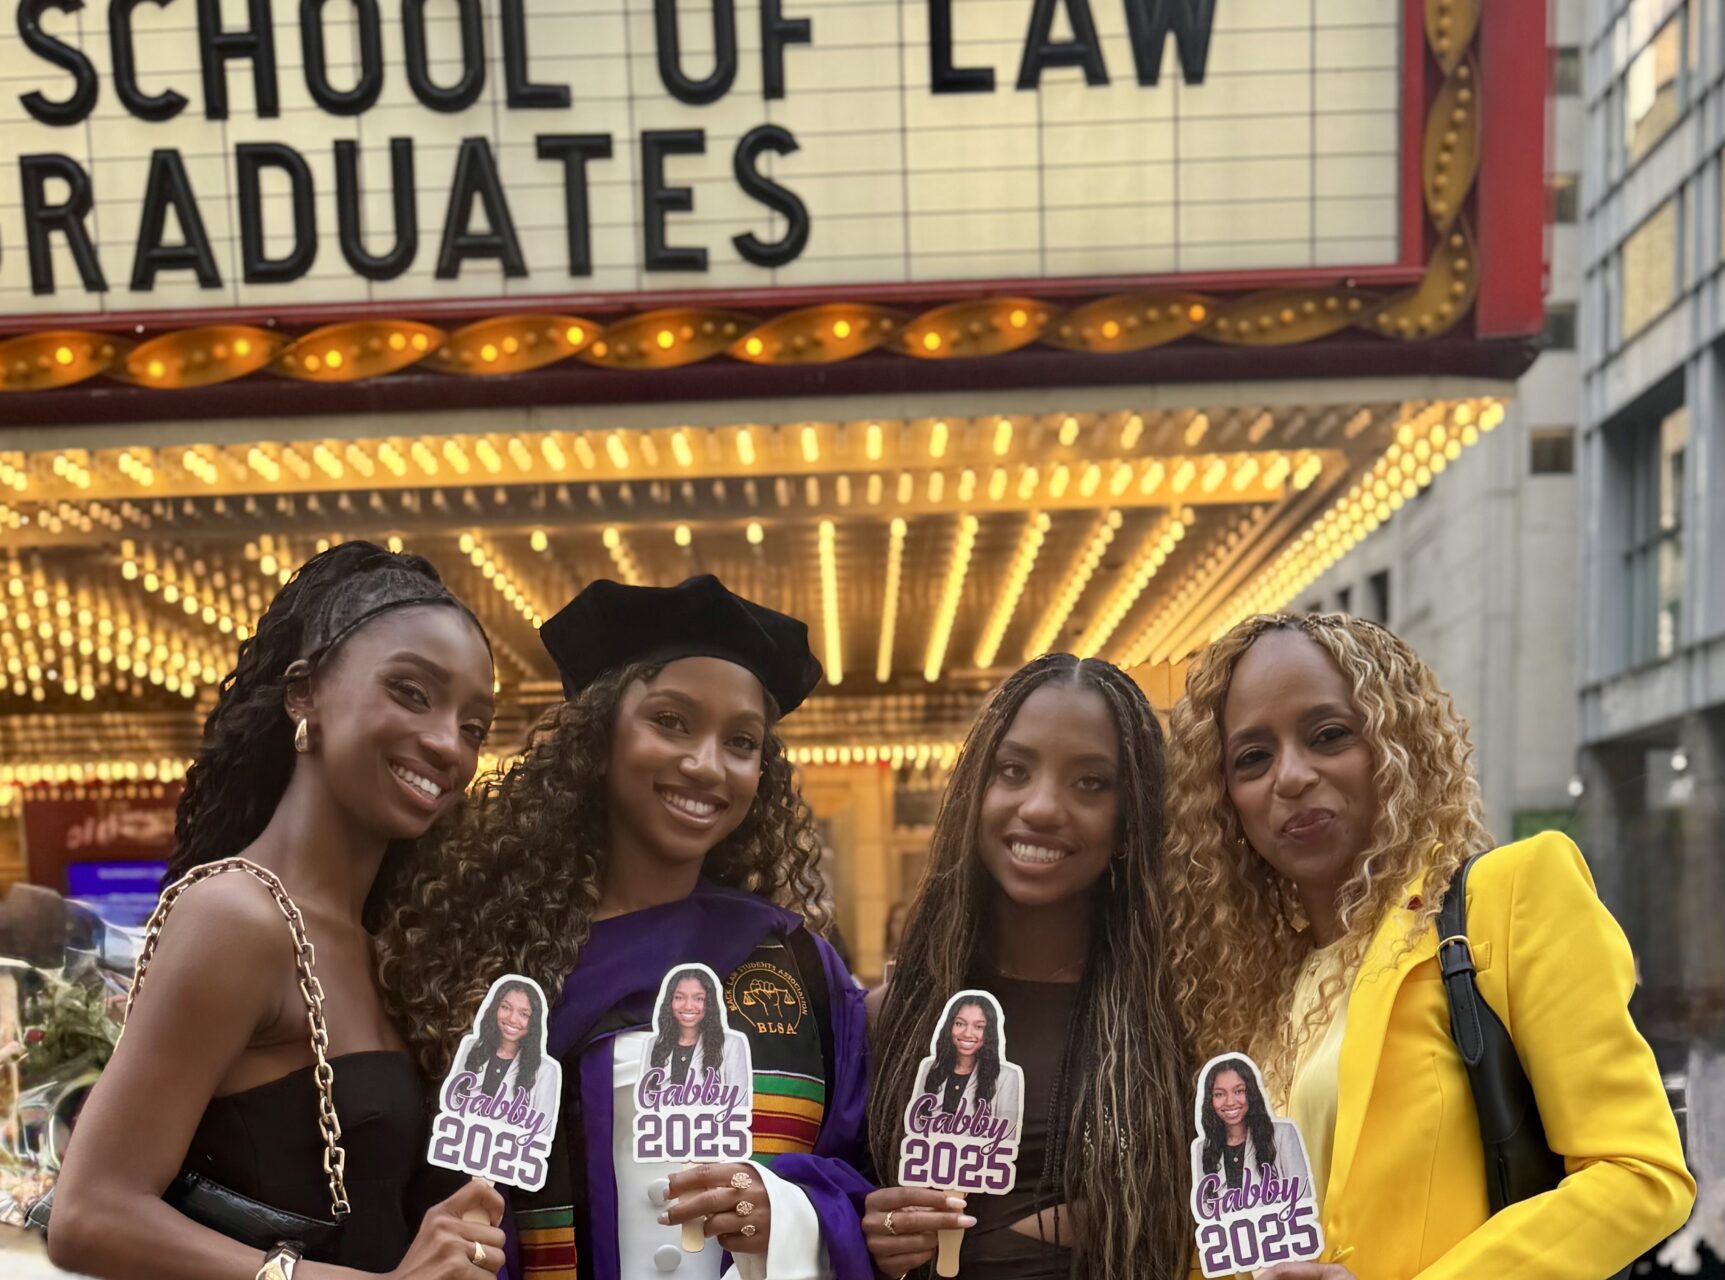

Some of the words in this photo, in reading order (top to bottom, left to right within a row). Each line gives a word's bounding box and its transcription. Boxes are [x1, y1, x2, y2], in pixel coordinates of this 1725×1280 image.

[16, 0, 571, 126] SCHOOL
[654, 0, 812, 105] OF
[928, 0, 1217, 94] LAW
[0, 124, 811, 294] RADUATES
[756, 1022, 797, 1035] BLSA
[445, 1071, 553, 1147] Gabby
[638, 1066, 748, 1124] Gabby
[909, 1093, 1017, 1156] Gabby
[433, 1116, 547, 1186] 2025
[637, 1113, 748, 1158] 2025
[903, 1138, 1013, 1190] 2025
[1196, 1162, 1309, 1222] Gabby
[1201, 1206, 1320, 1273] 2025
